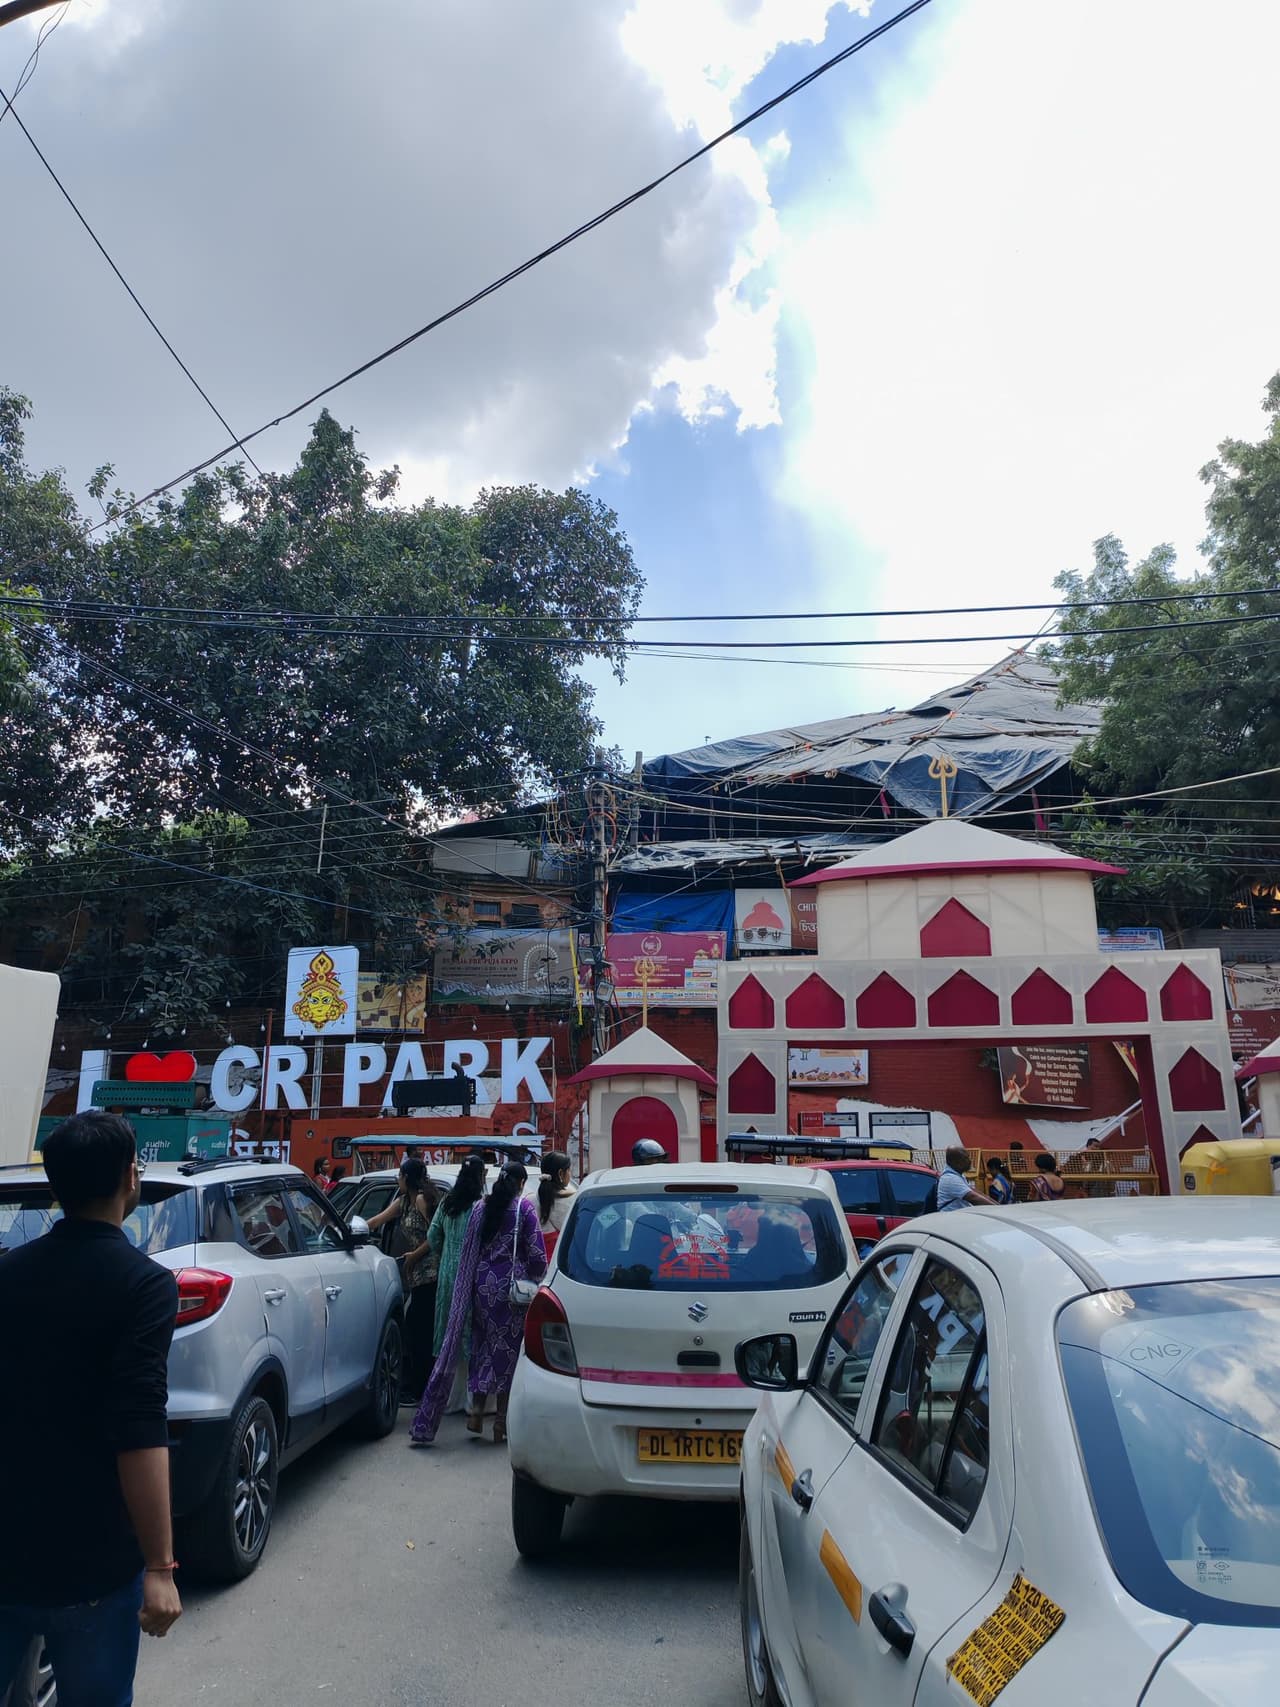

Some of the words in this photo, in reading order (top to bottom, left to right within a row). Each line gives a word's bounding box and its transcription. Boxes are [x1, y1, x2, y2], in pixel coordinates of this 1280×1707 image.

[211, 1045, 309, 1112] CR
[342, 1037, 553, 1108] PARK
[145, 1140, 171, 1150] sudhir
[1130, 1344, 1182, 1360] CNG
[650, 1436, 670, 1456] DL
[1039, 1599, 1065, 1627] 8640
